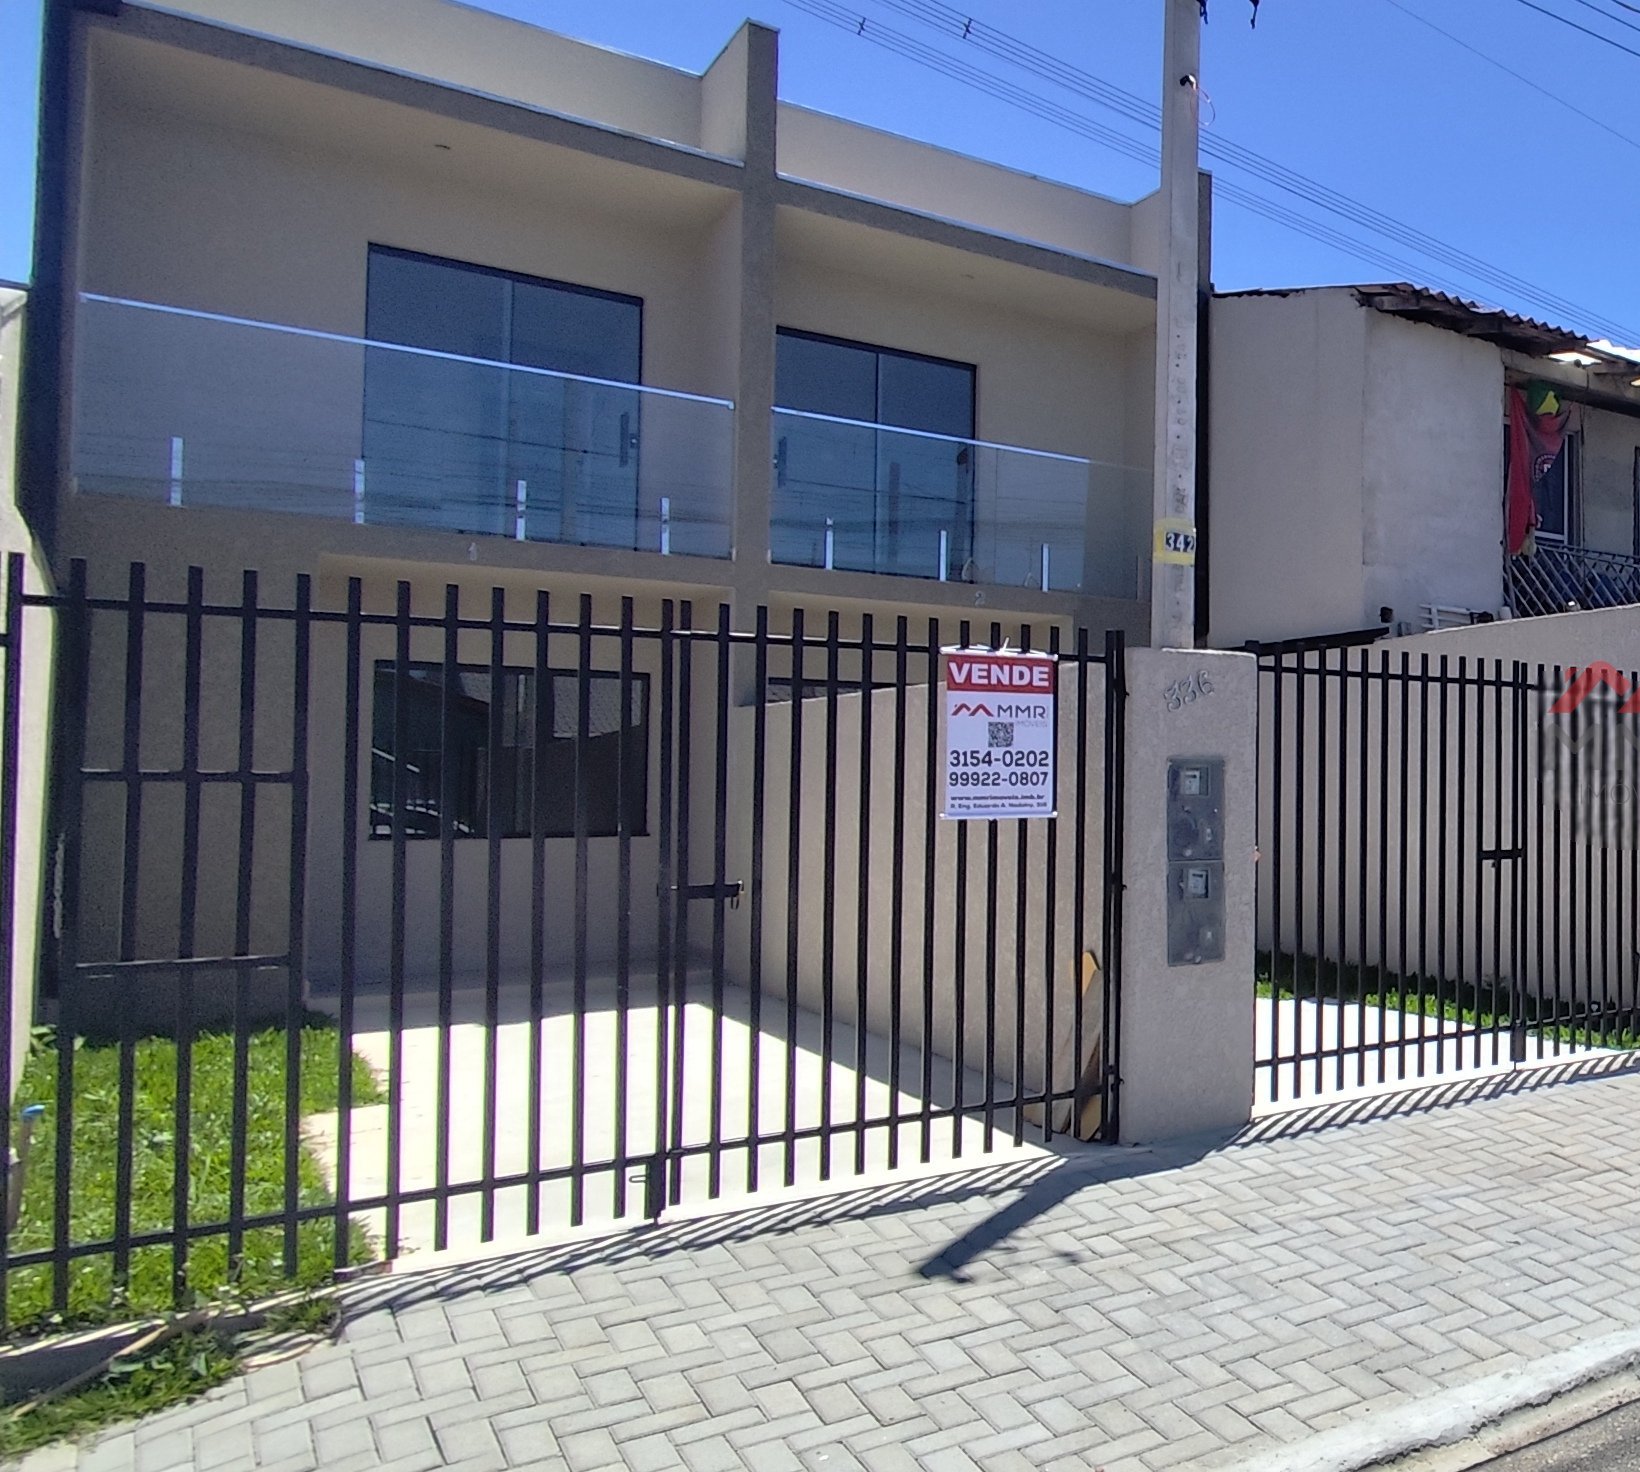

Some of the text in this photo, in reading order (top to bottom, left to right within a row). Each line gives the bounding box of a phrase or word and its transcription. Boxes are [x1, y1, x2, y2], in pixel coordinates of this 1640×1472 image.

[1166, 532, 1195, 553] 342
[949, 662, 1049, 687] VENDE
[997, 704, 1046, 719] MMR
[950, 750, 1049, 767] 3154-0202
[949, 771, 1049, 787] 99922-0807
